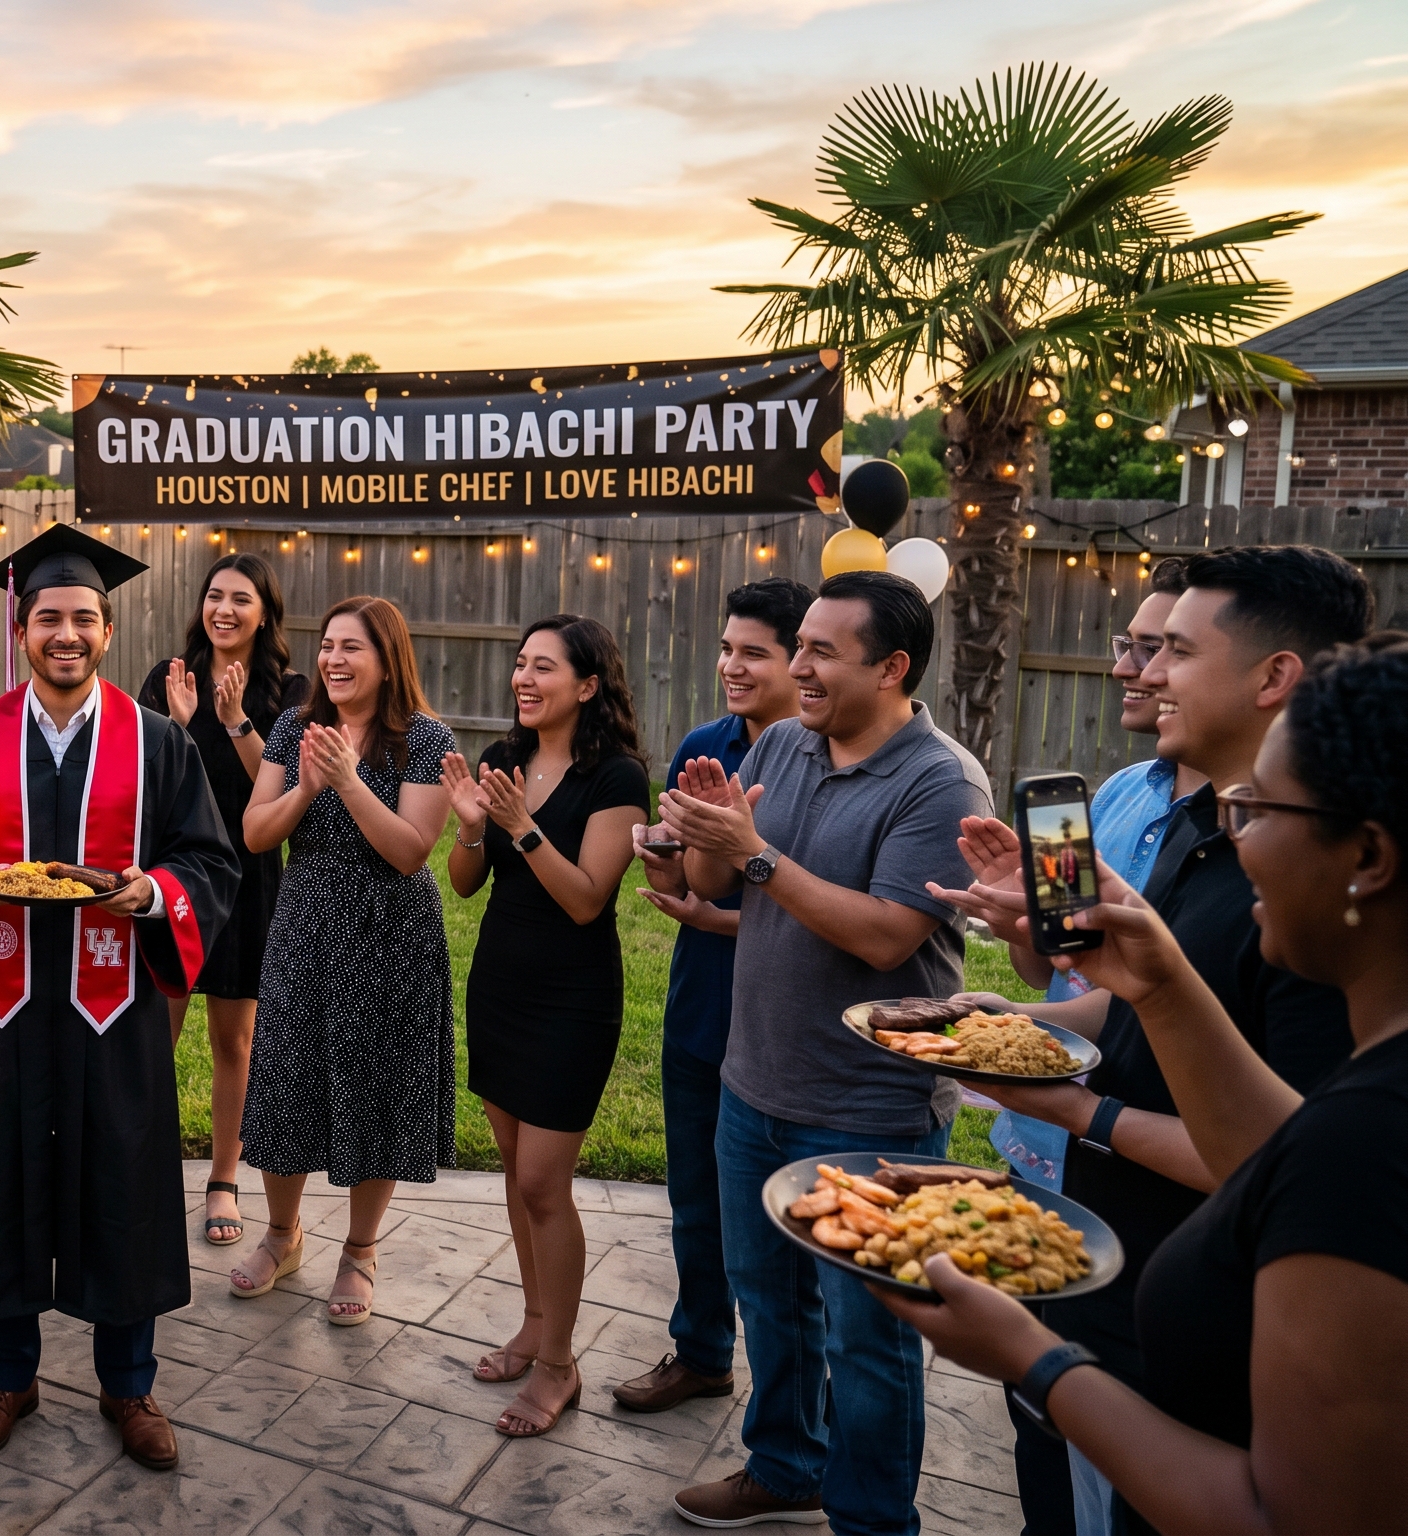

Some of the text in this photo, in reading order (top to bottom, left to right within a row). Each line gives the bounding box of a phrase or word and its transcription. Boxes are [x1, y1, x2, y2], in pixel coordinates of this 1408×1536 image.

[97, 398, 819, 464] GRADUATION HIBACHI PARTY
[156, 475, 290, 505] HOUSTON
[321, 473, 429, 504] MOBILE
[439, 471, 514, 502] CHEF
[545, 468, 618, 500] LOVE
[628, 464, 754, 497] HIBACHI
[84, 927, 123, 967] UH
